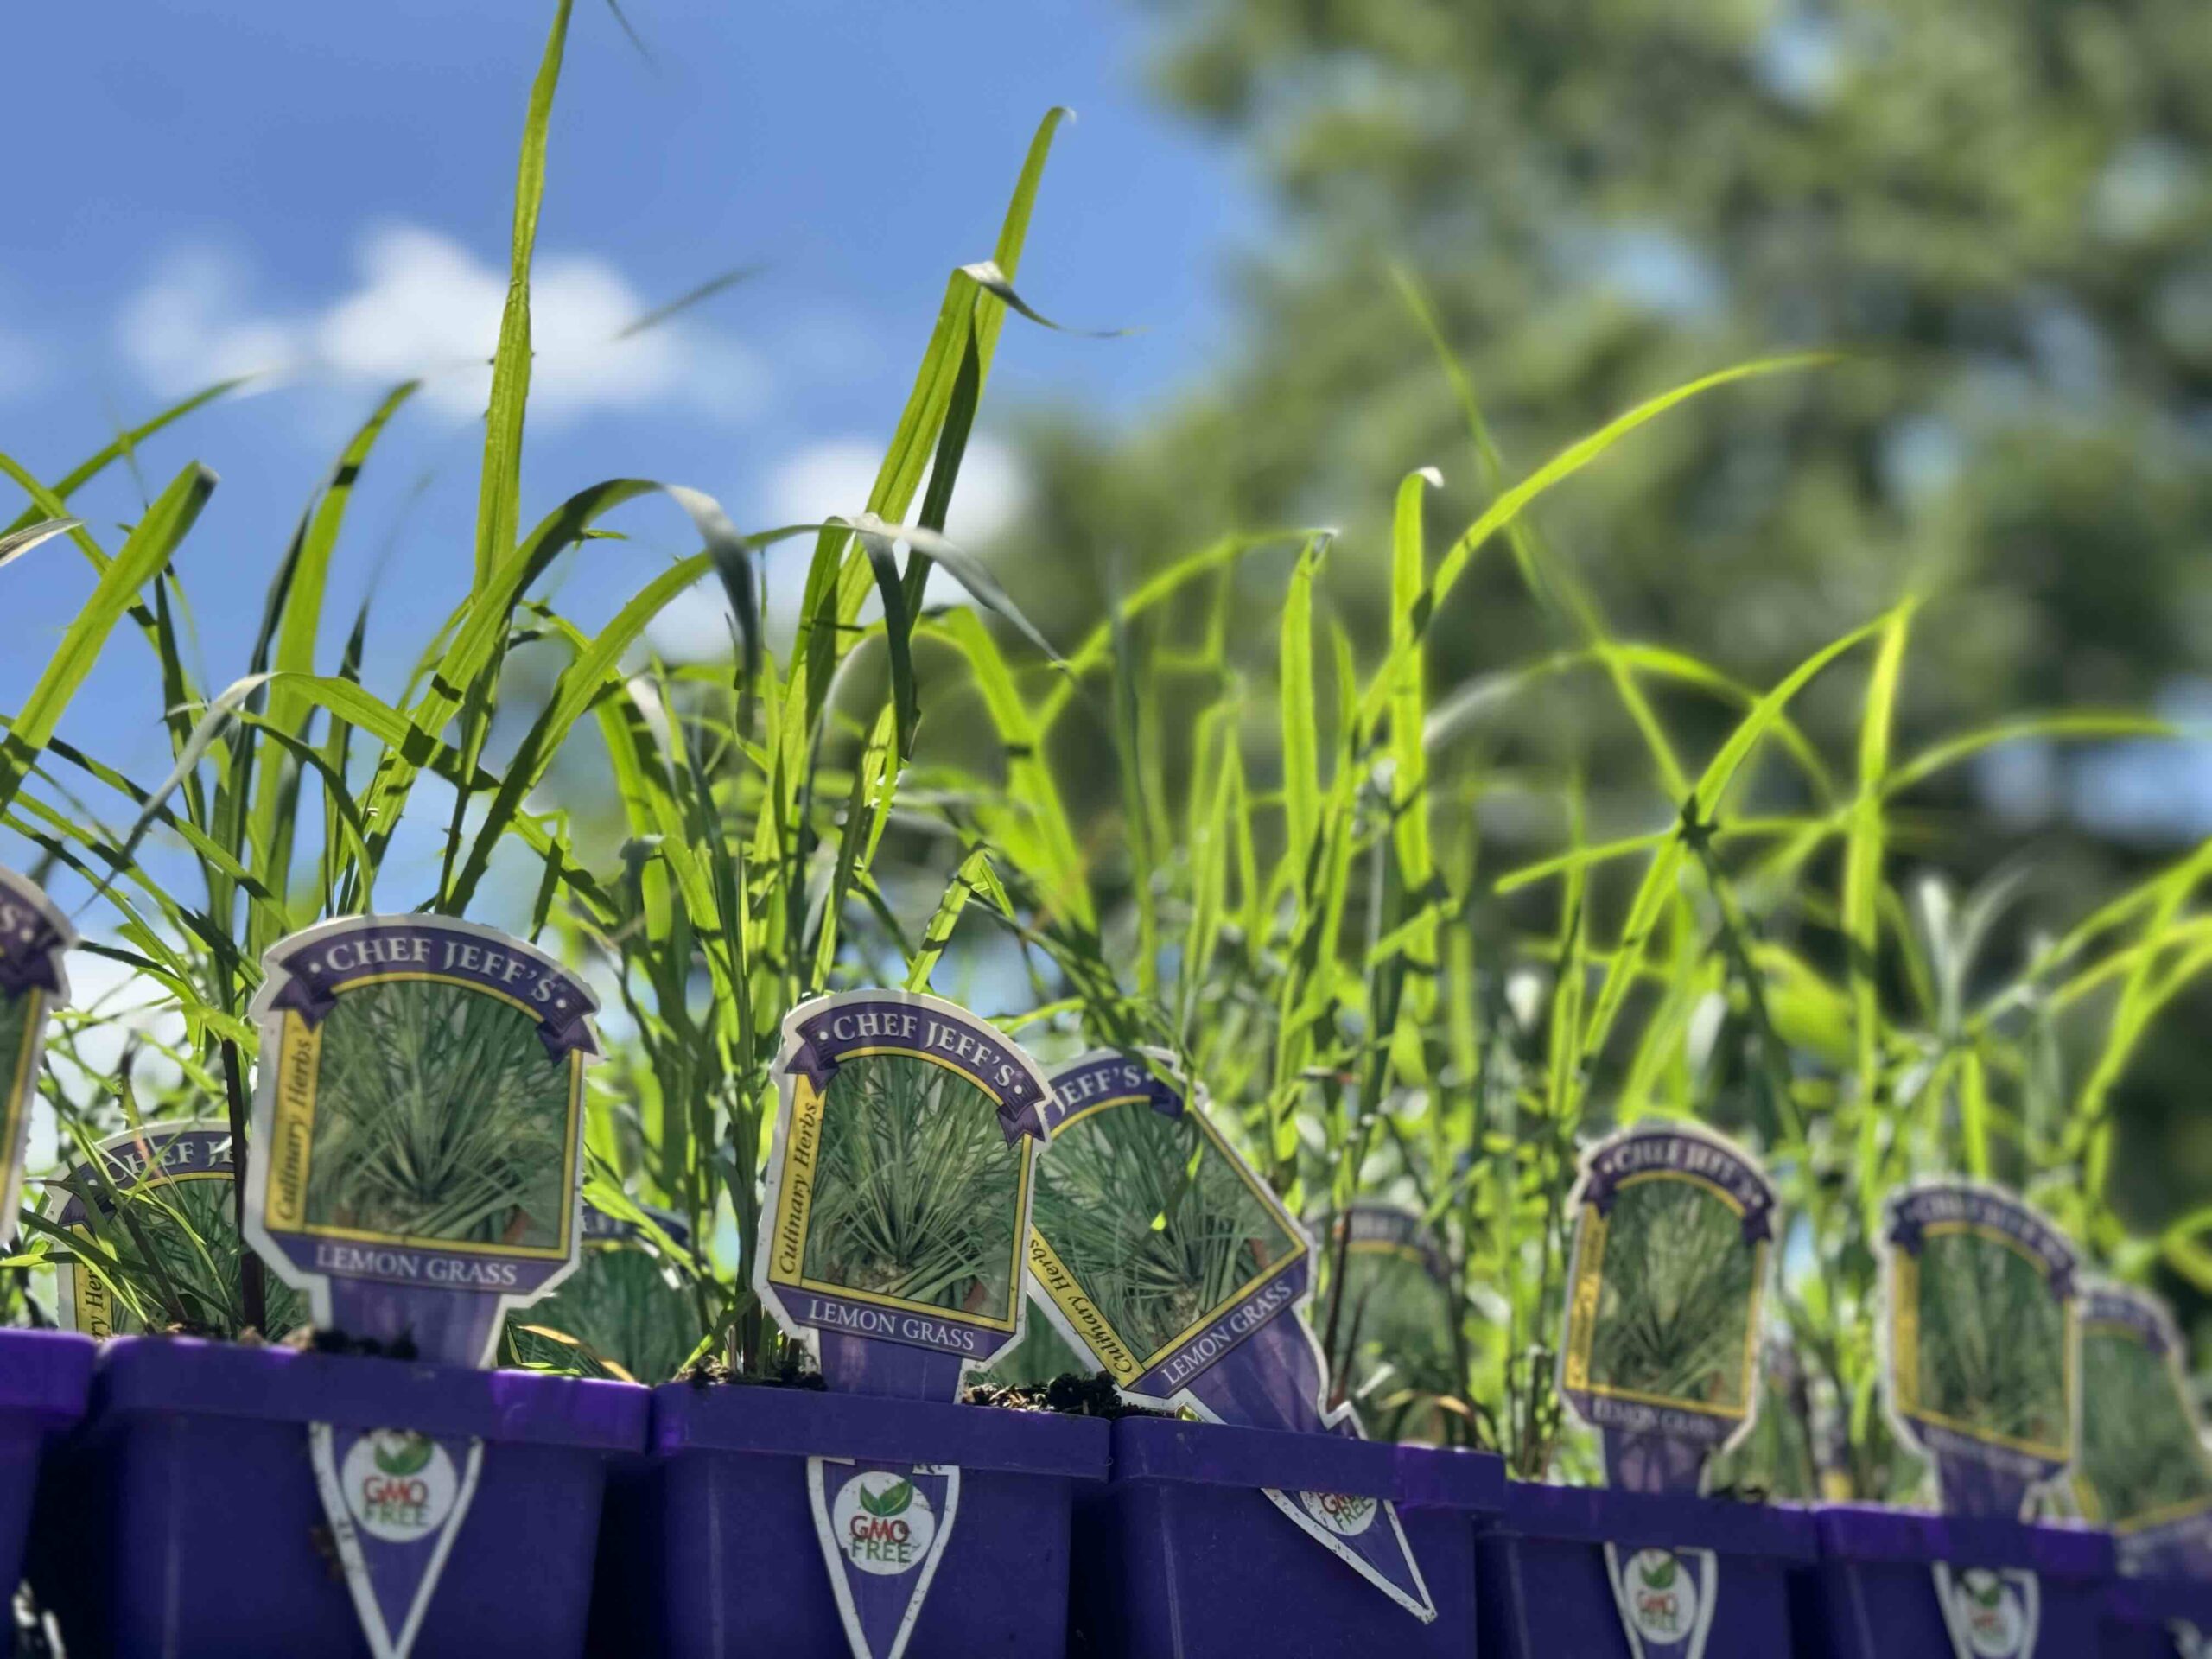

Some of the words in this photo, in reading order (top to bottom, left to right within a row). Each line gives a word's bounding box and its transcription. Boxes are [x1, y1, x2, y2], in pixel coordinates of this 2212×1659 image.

[326, 937, 434, 971] CHEF
[443, 941, 557, 1002] JEFF'S
[287, 1039, 312, 1108] Herbs
[833, 1013, 918, 1041] CHEF
[925, 1020, 1016, 1088] JEFF'S
[1051, 1065, 1141, 1116] JEFF'S
[793, 1103, 817, 1169] Herbs
[276, 1115, 309, 1221] Culinary
[779, 1174, 811, 1274] Culinary
[316, 1244, 421, 1279] LEMON
[426, 1258, 518, 1286] GRASS
[1028, 1239, 1071, 1292] Herbs
[810, 1300, 897, 1335] LEMON
[903, 1319, 975, 1351] GRASS
[1068, 1296, 1133, 1373] Culinary
[1161, 1325, 1234, 1386] LEMON
[1230, 1280, 1292, 1333] GRASS
[363, 1475, 429, 1508] GMO
[364, 1503, 430, 1527] FREE
[850, 1515, 910, 1544] GMO
[851, 1538, 912, 1563] FREE
